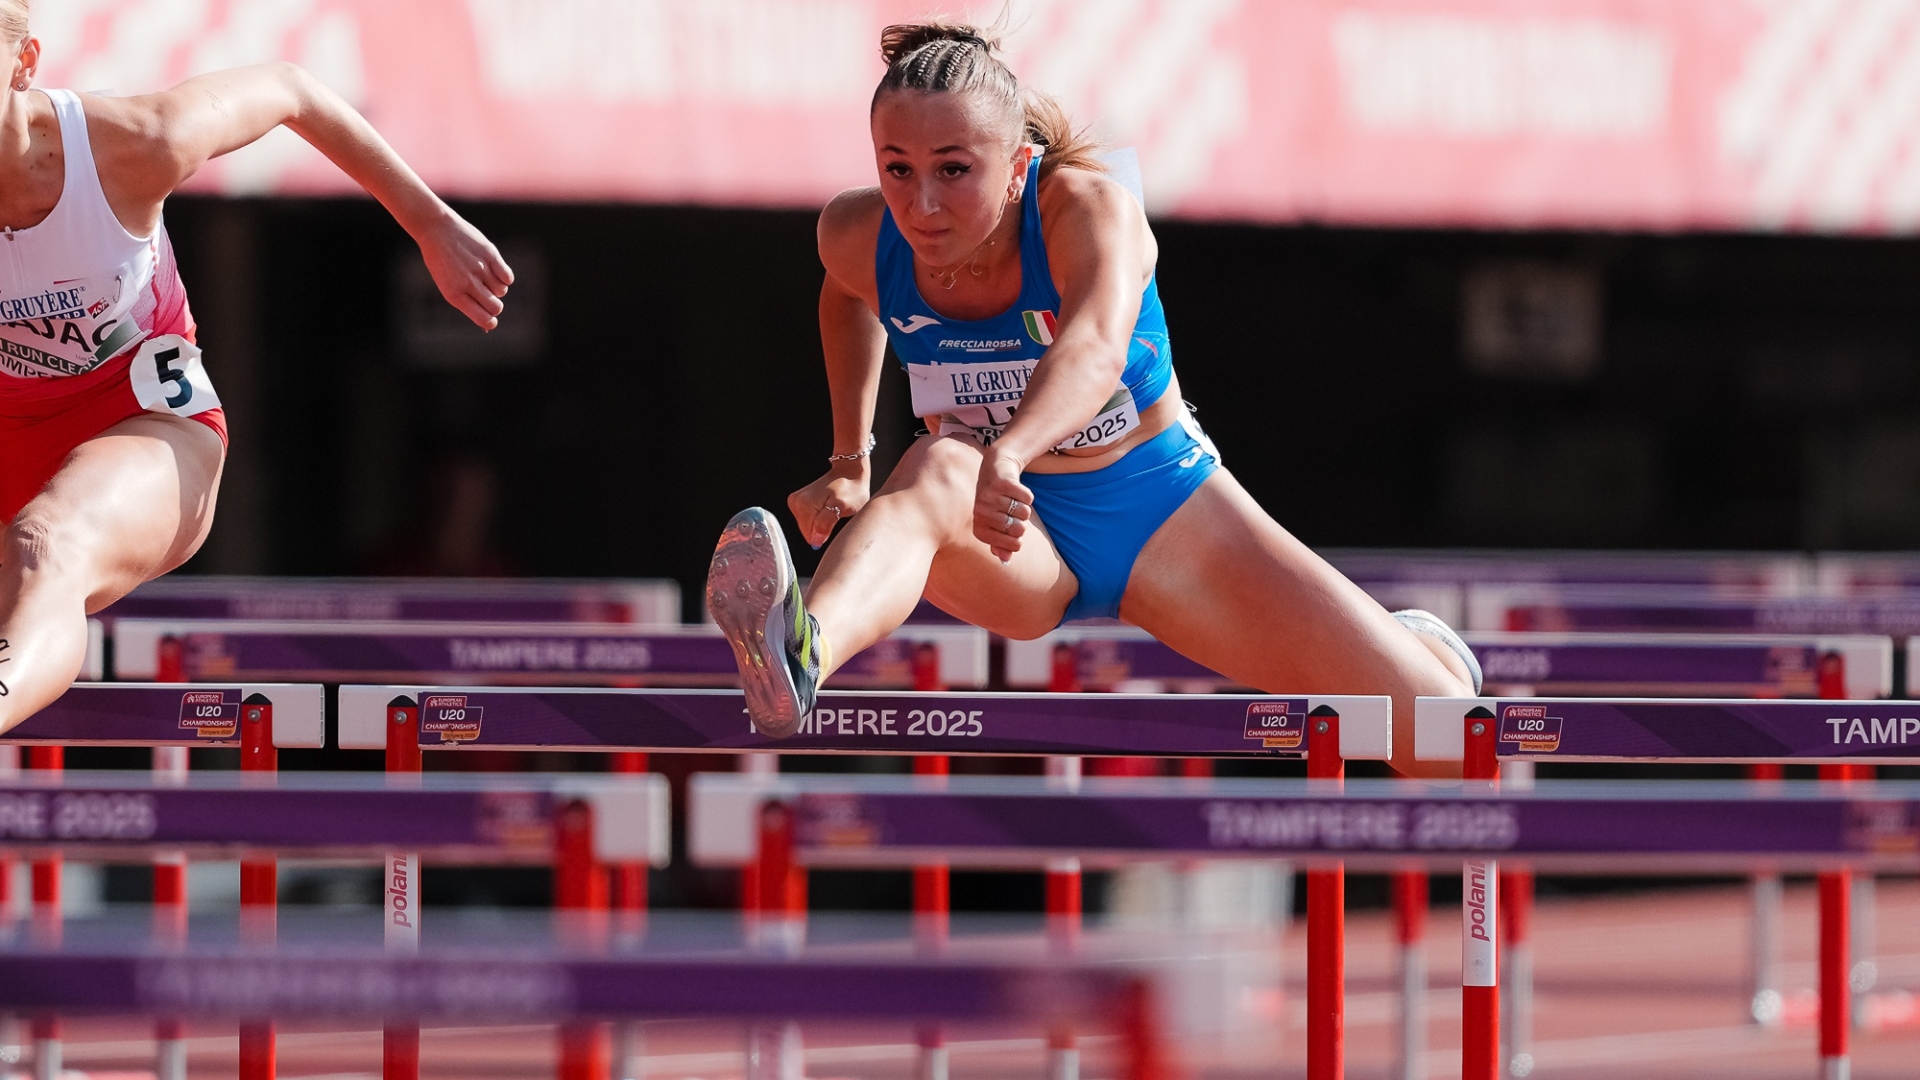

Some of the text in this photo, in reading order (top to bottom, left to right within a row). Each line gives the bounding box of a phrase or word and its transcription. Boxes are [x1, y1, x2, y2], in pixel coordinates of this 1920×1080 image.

[7, 342, 43, 364] RUN
[938, 338, 1022, 349] FRECCIAROSSA
[154, 346, 193, 409] 5
[951, 364, 1035, 394] LE GRUYÈ
[959, 391, 1025, 404] SWITZER
[1072, 411, 1128, 448] 2025
[196, 706, 222, 717] U20
[439, 709, 466, 720] U20
[907, 709, 984, 736] 2025
[1262, 716, 1287, 727] U20
[1518, 720, 1544, 731] U20
[389, 852, 412, 929] polani
[1467, 861, 1490, 942] polani
